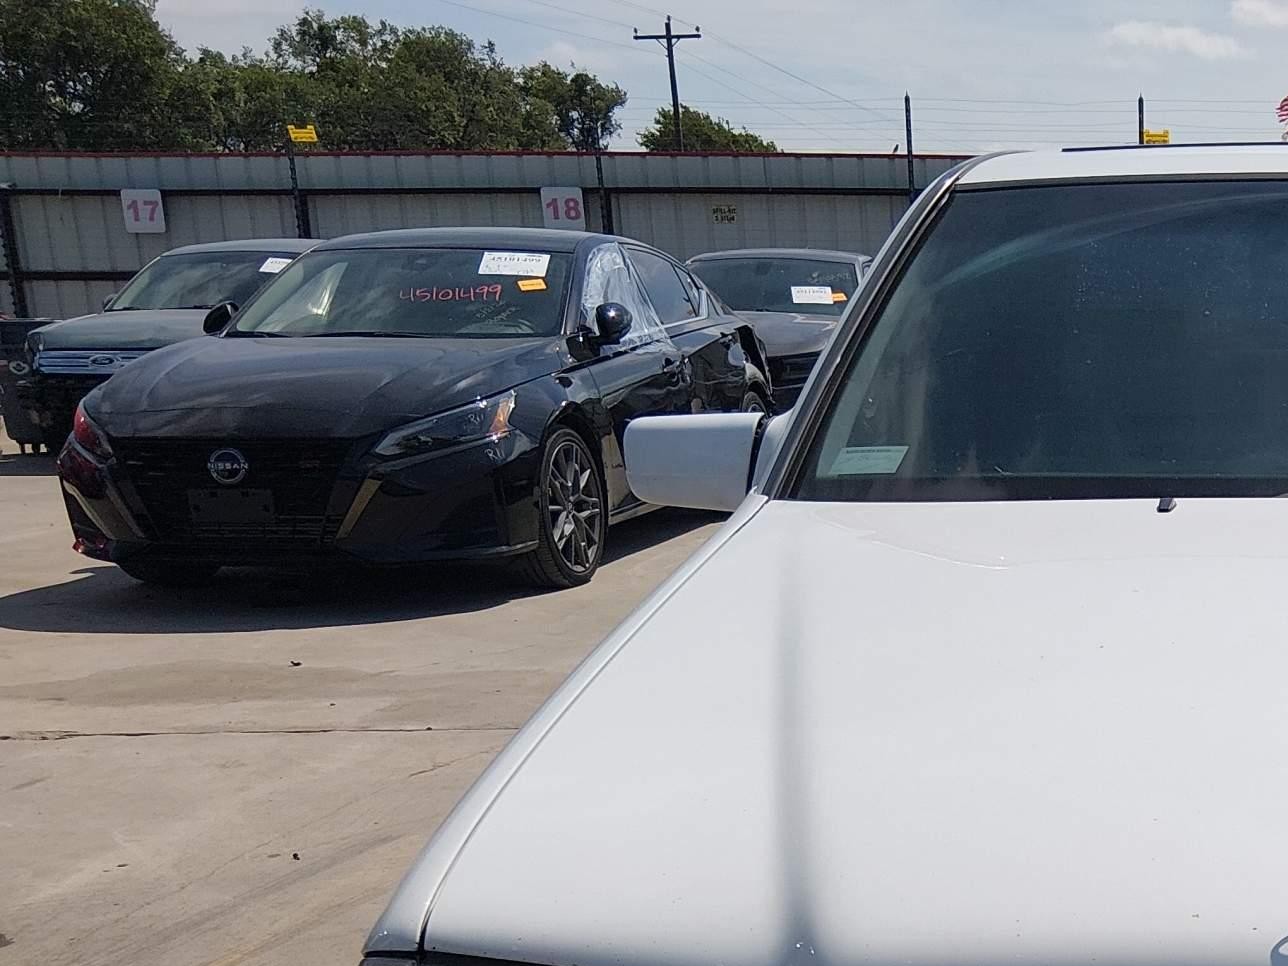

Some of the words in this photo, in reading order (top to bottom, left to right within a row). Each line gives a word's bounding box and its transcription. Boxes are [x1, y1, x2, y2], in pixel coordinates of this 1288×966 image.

[127, 200, 159, 222] 17
[546, 198, 581, 220] 18
[400, 284, 502, 302] 45101499
[208, 462, 249, 470] NISSAN
